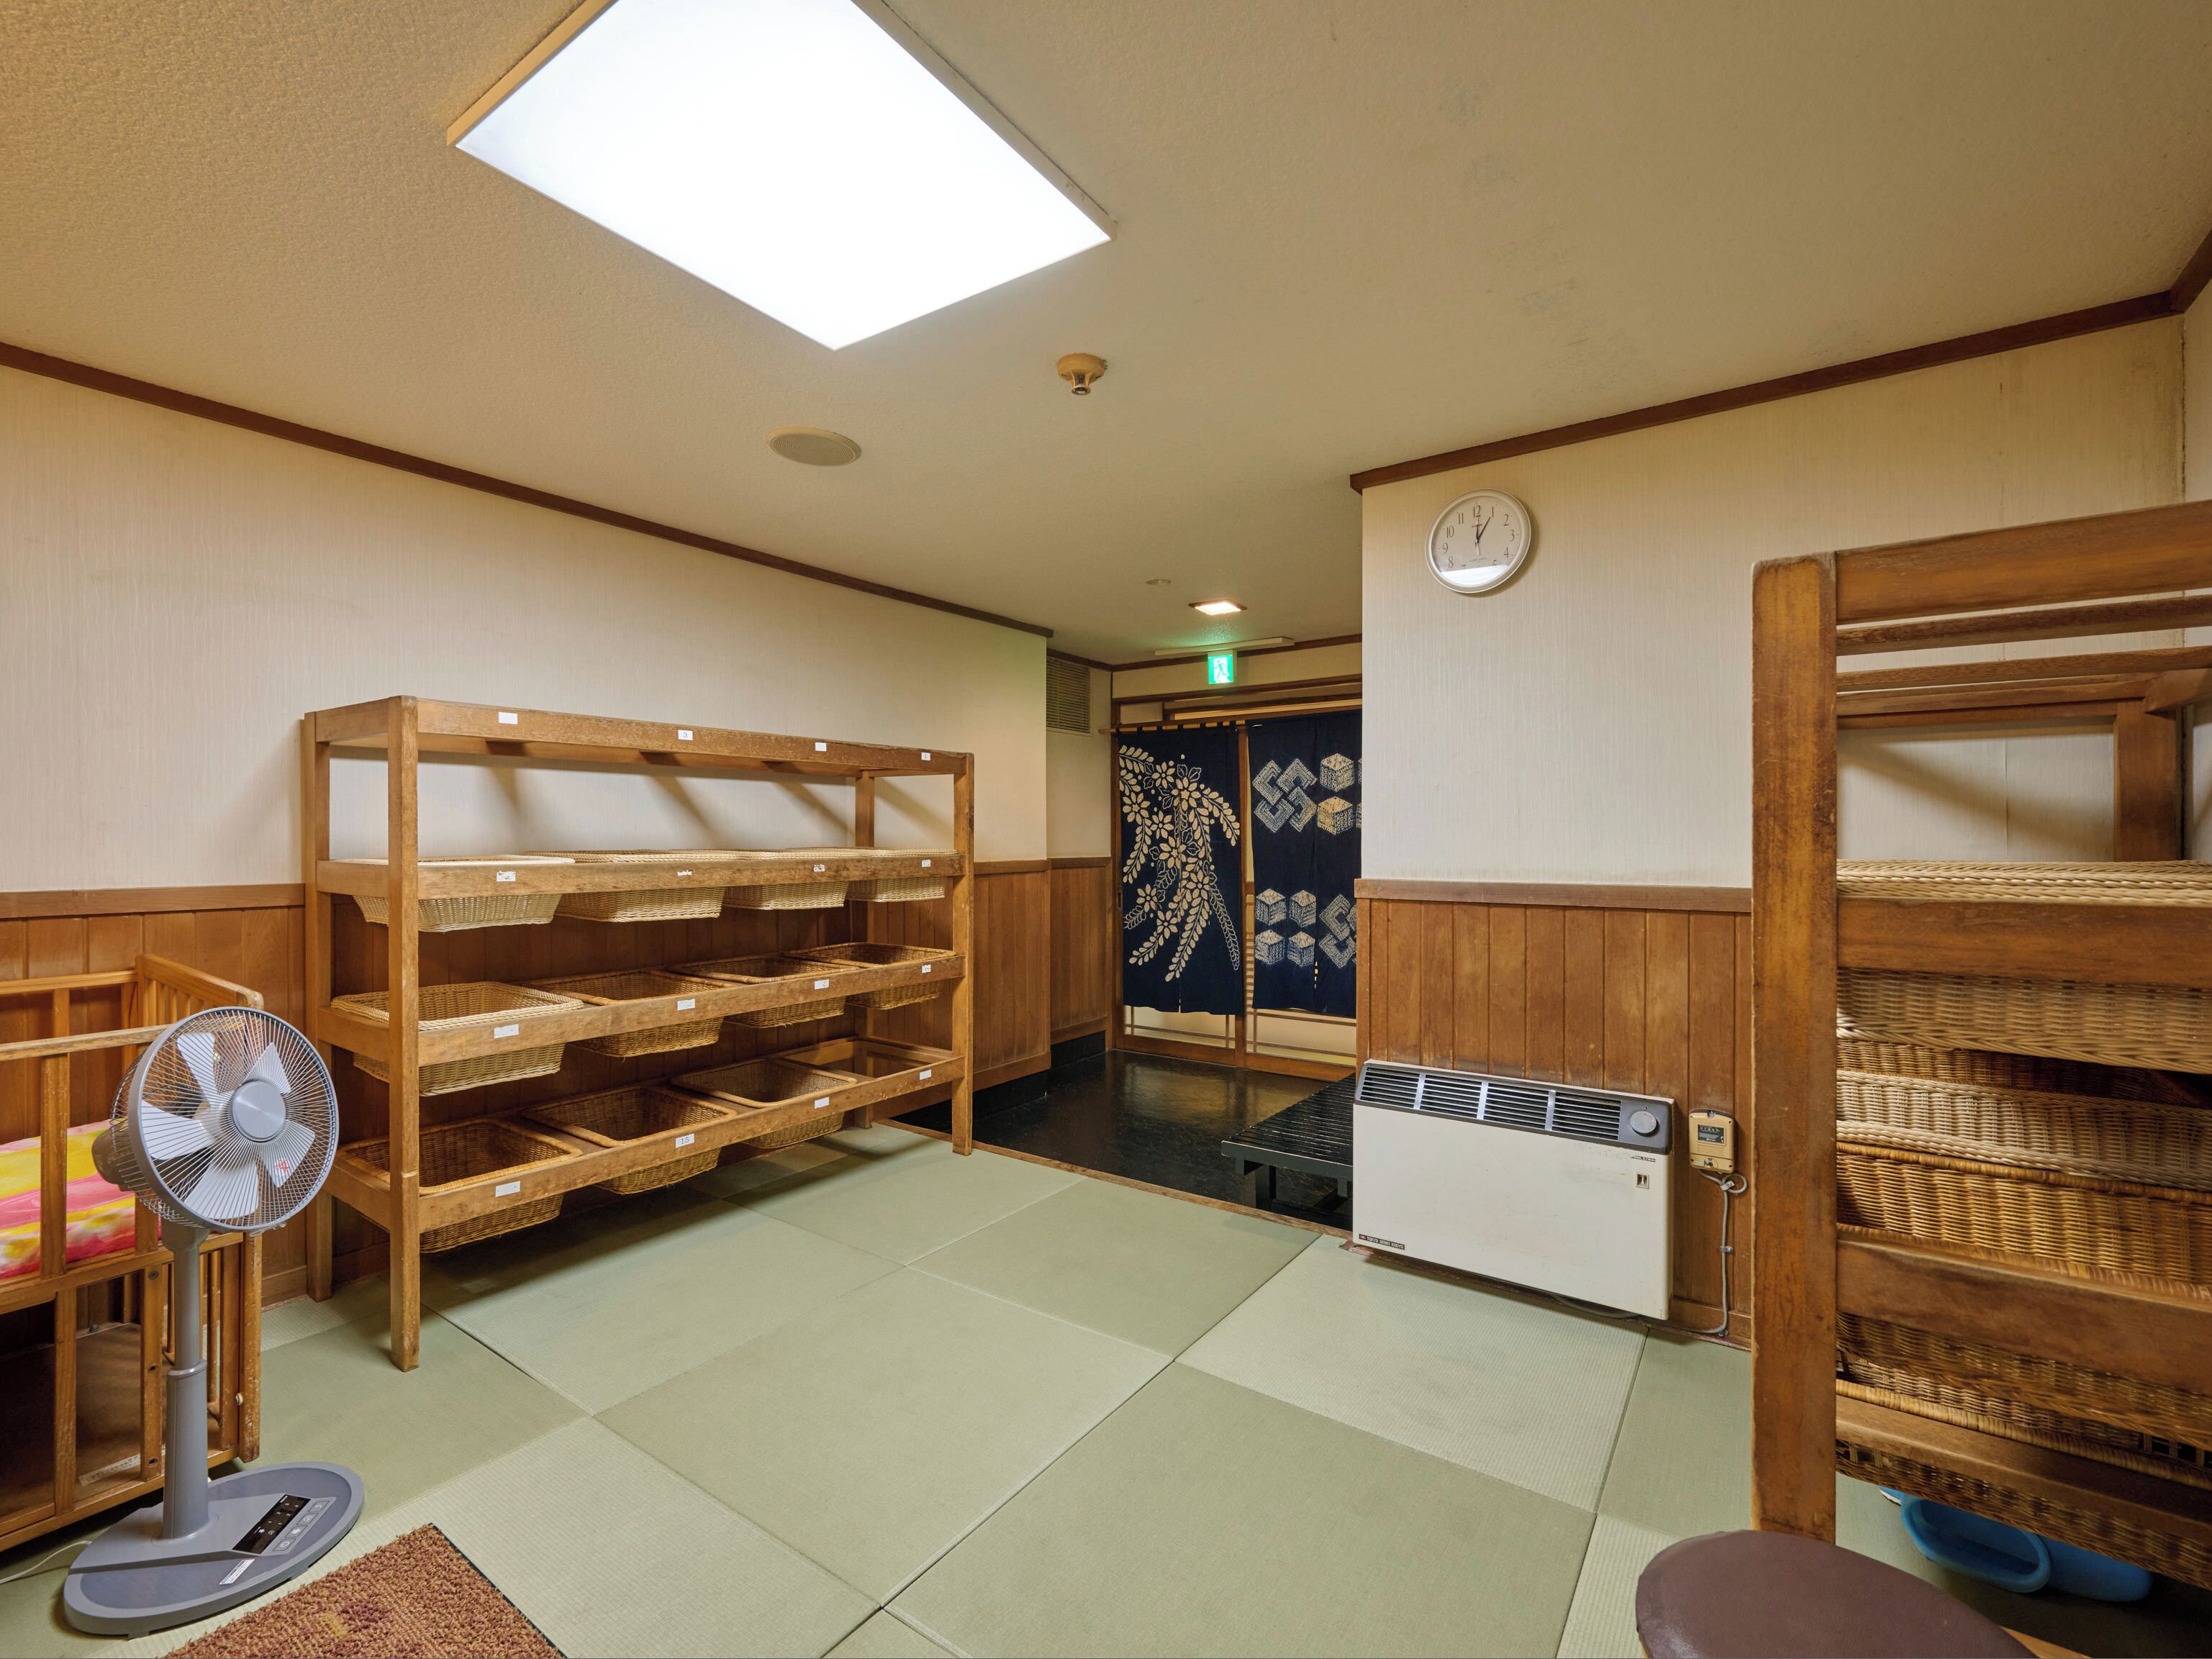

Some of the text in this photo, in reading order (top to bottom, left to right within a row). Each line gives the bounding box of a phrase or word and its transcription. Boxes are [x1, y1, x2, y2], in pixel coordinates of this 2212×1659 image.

[1458, 512, 1464, 524] 11
[1473, 506, 1481, 518] 12
[1503, 514, 1509, 526] 2
[1446, 525, 1454, 538] 10
[1509, 529, 1515, 542] 3
[1442, 542, 1449, 555] 9
[1503, 547, 1509, 558] 4
[1448, 556, 1454, 568] 8
